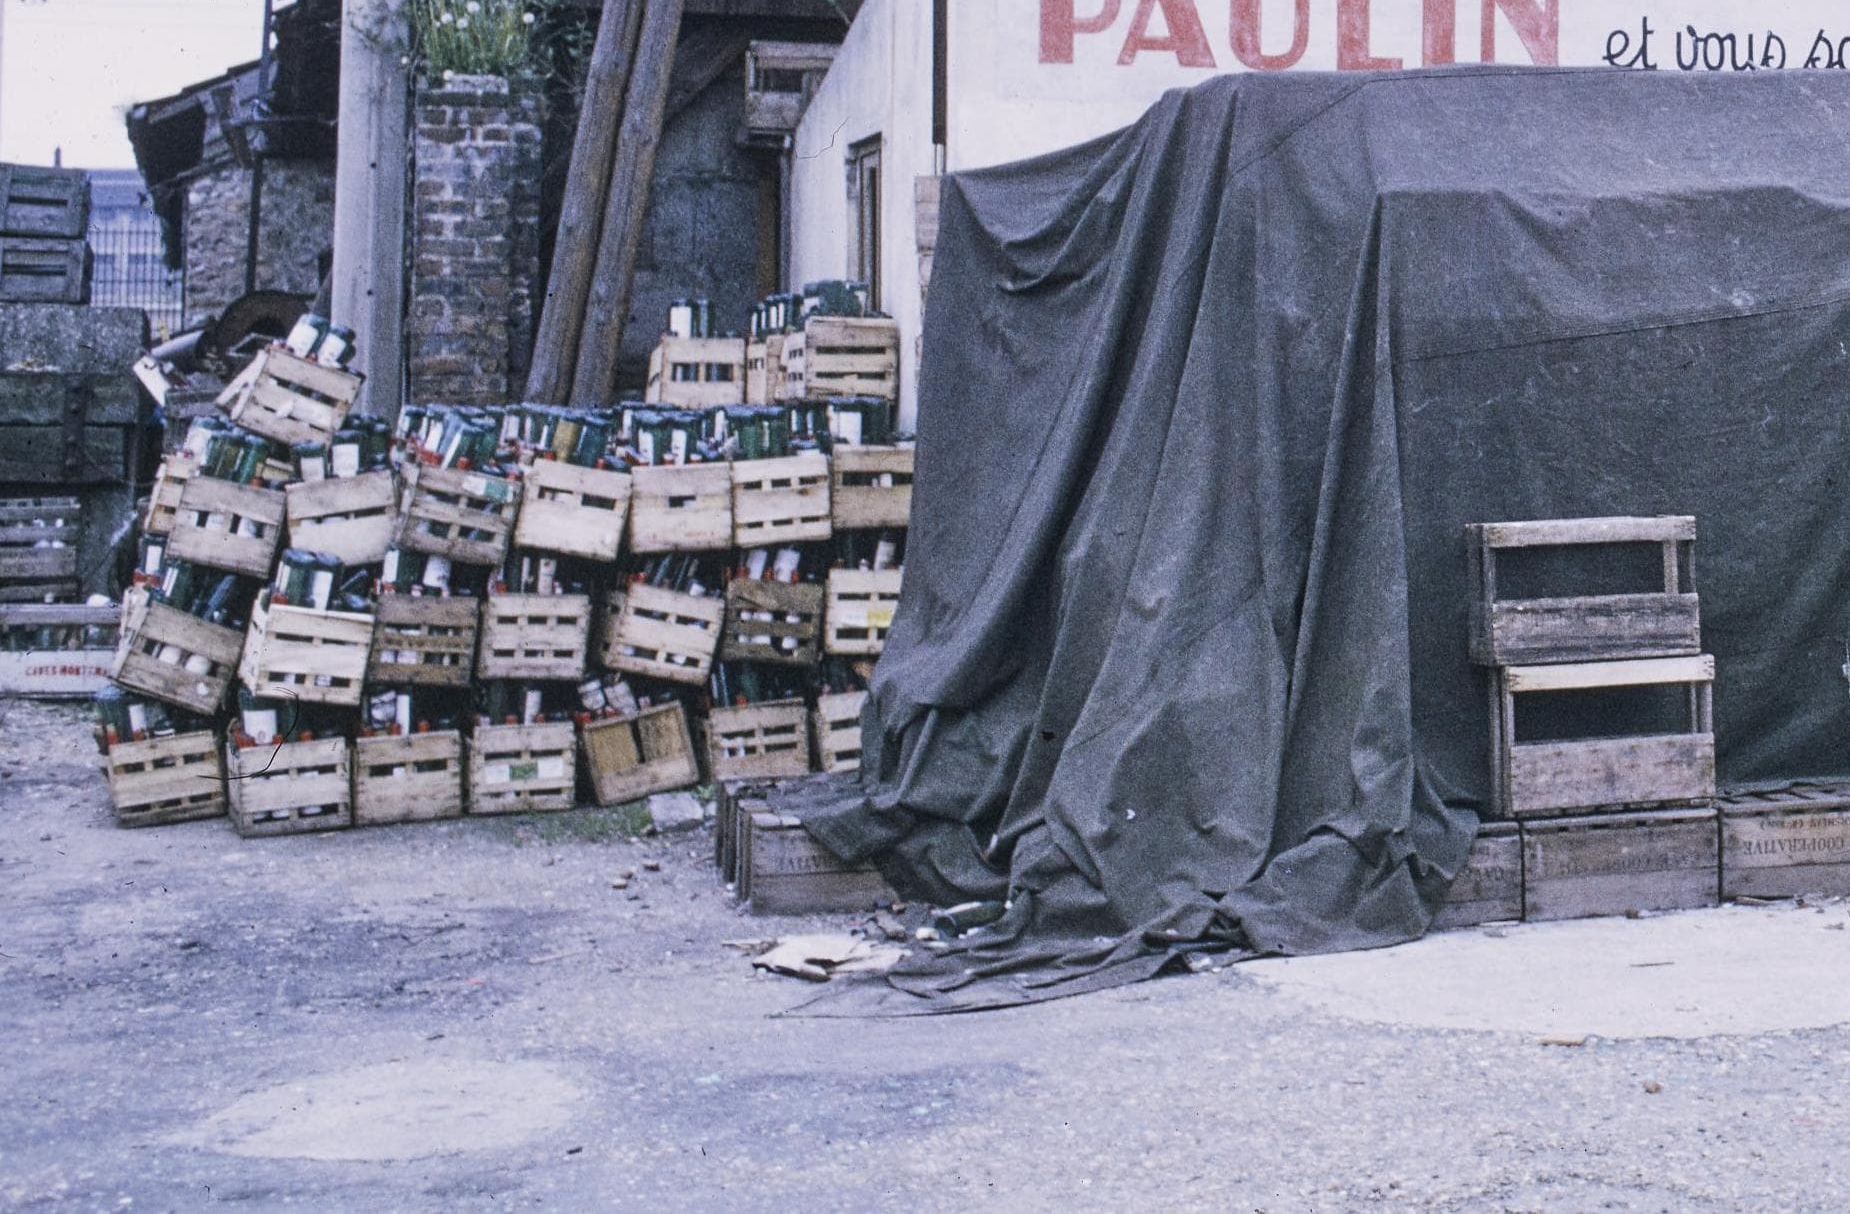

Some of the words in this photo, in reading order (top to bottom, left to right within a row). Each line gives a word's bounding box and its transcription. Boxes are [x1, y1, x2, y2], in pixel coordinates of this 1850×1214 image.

[1602, 16, 1658, 70] et
[1675, 24, 1787, 72] vous
[1743, 836, 1846, 855] COOPERATIVE
